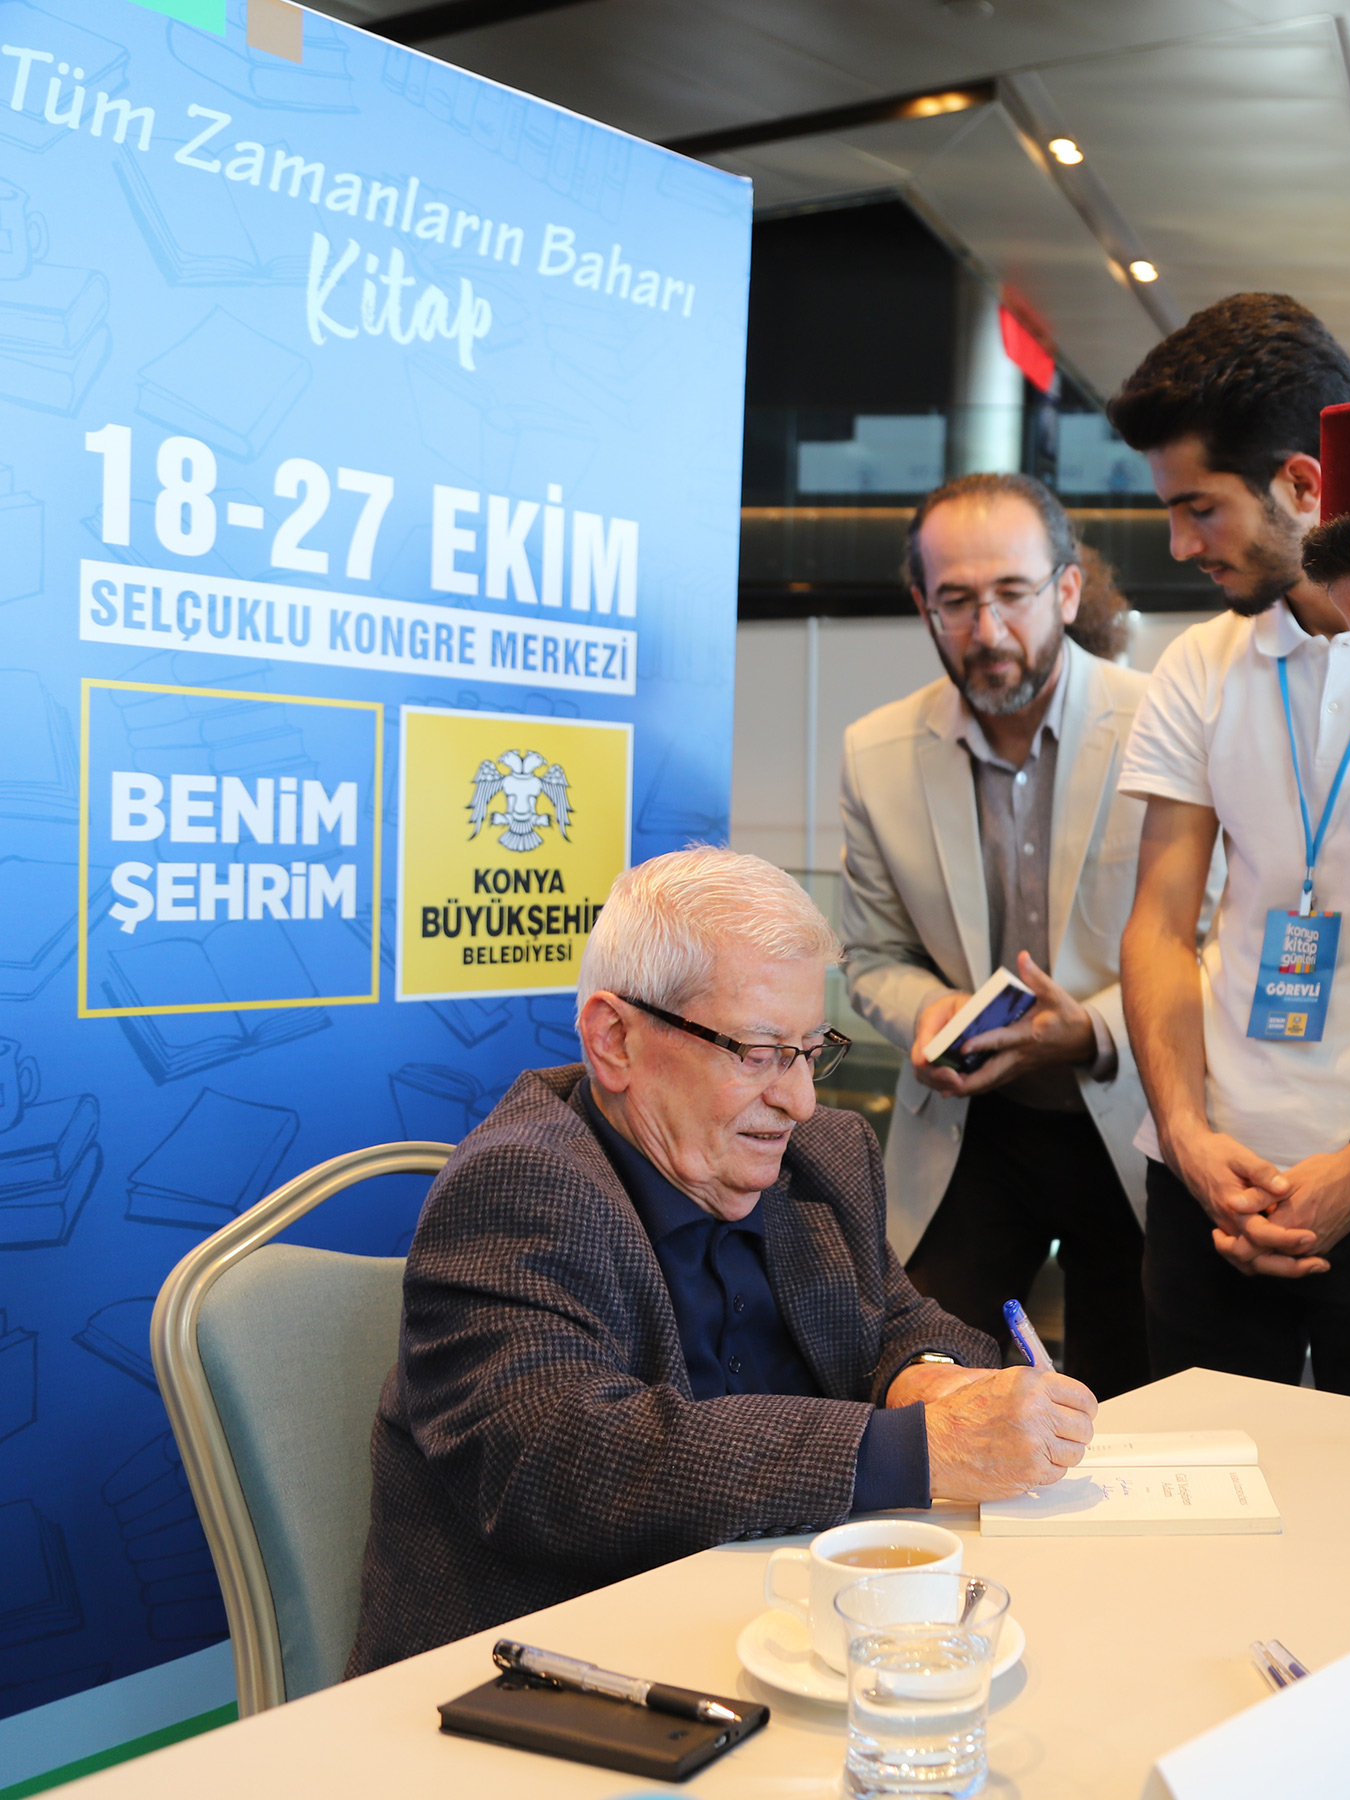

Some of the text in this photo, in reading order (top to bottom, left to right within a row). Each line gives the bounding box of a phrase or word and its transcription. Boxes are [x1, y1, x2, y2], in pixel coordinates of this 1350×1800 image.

[1, 44, 696, 318] Tüm Zamanların Baharı
[306, 231, 494, 371] Kitap
[85, 423, 639, 619] 18-27 EKİM
[89, 579, 629, 682] SELÇUKLU KONGRE MERKEZİ
[474, 868, 565, 894] KONYA
[1286, 923, 1319, 942] konya
[463, 940, 572, 965] BELEDİYESİ
[1283, 936, 1318, 956] kitap
[1266, 981, 1321, 997] GÖREVLİ
